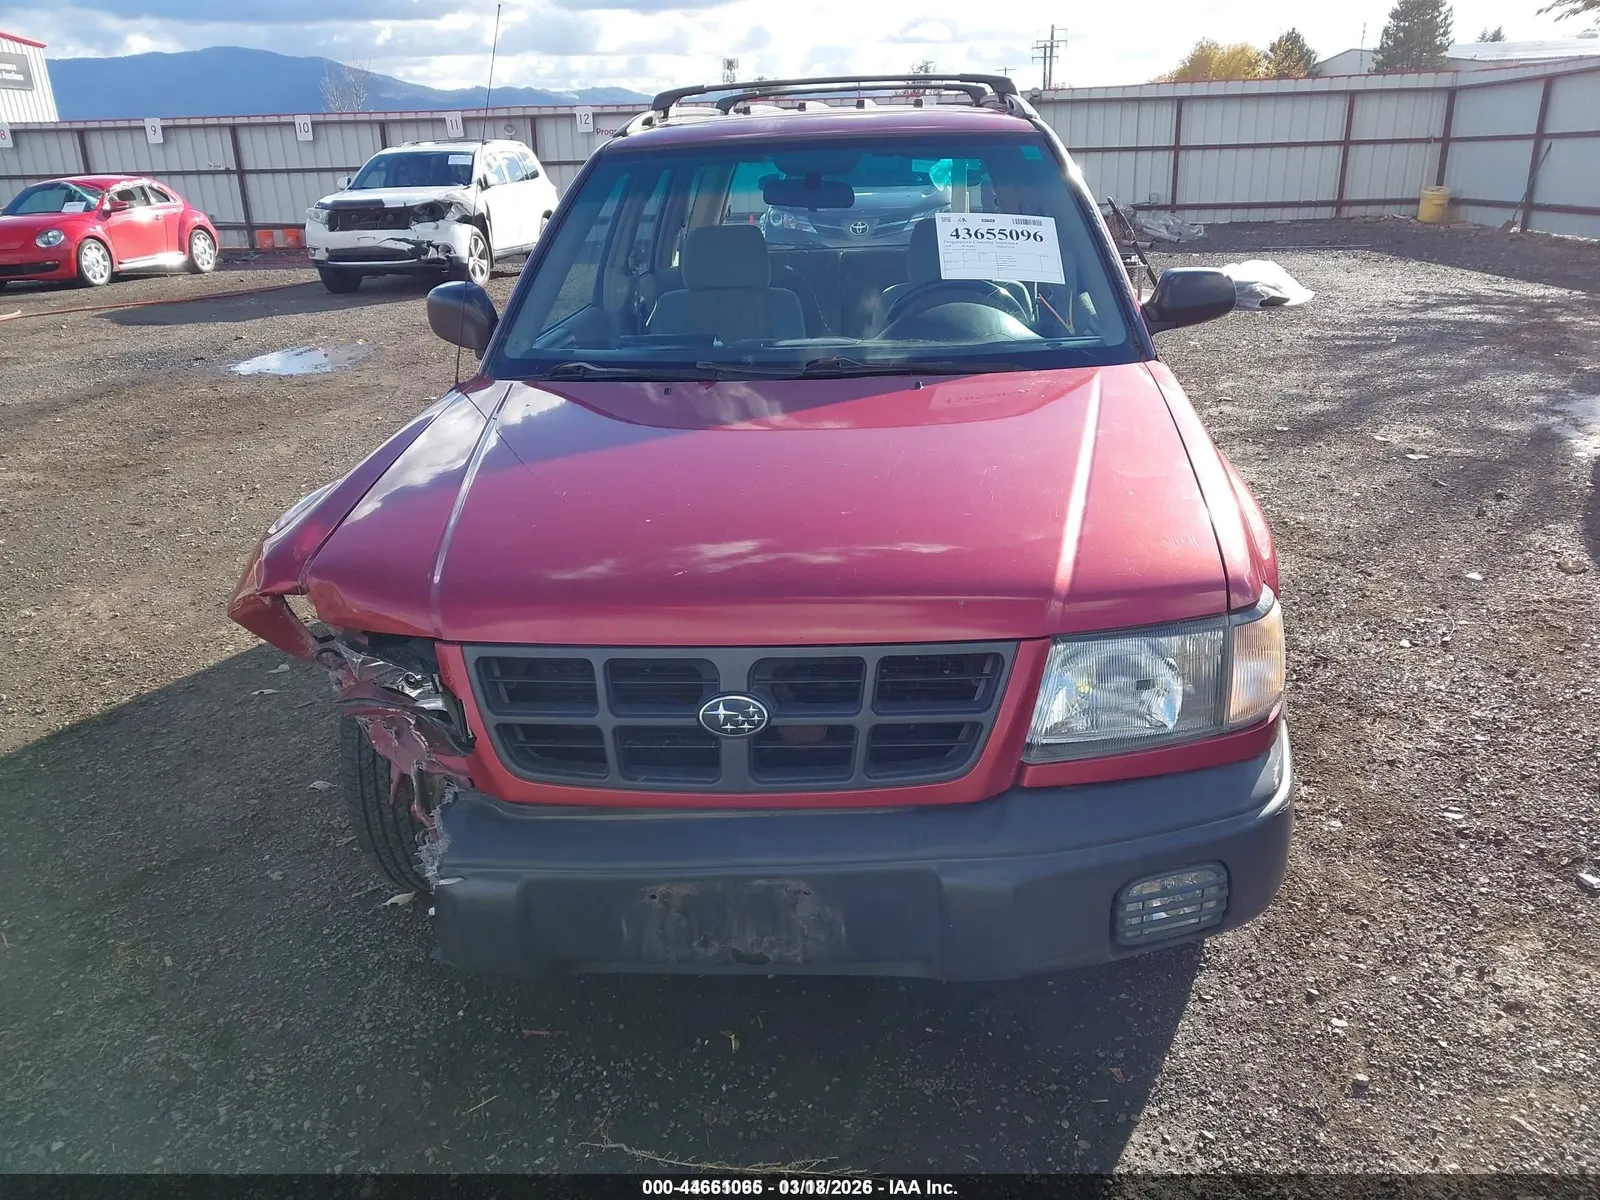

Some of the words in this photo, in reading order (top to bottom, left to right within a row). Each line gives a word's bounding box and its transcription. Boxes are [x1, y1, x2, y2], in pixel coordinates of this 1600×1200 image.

[449, 118, 459, 130] 11
[579, 113, 590, 125] 12
[150, 124, 157, 136] 9
[297, 122, 309, 134] 10
[0, 129, 6, 140] 8
[949, 227, 1044, 243] 43655096
